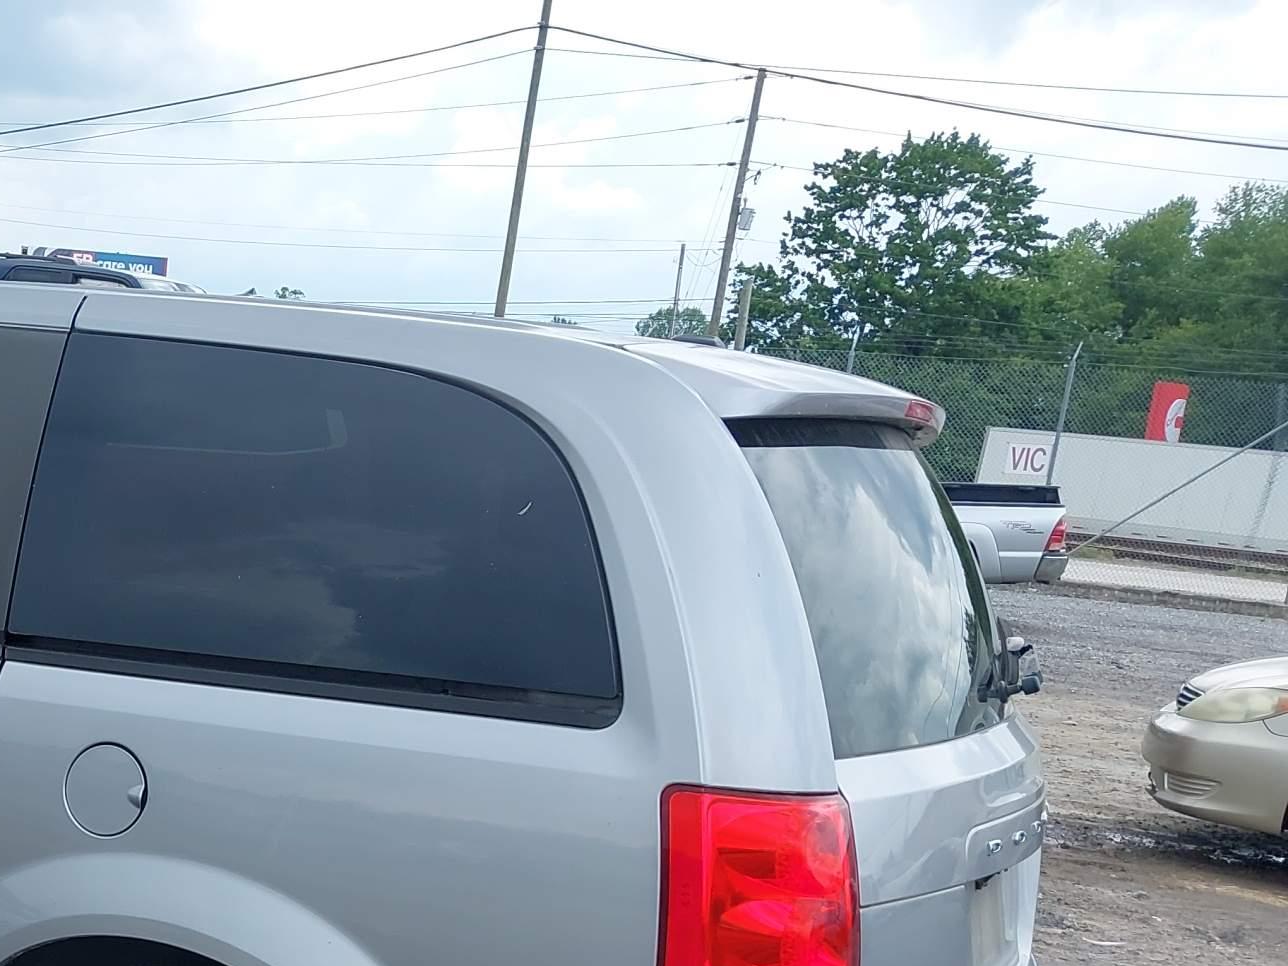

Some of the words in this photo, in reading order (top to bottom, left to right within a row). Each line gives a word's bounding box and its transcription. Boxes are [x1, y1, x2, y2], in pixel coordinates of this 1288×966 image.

[96, 259, 126, 270] care
[128, 262, 153, 274] you
[1011, 446, 1047, 473] VIC
